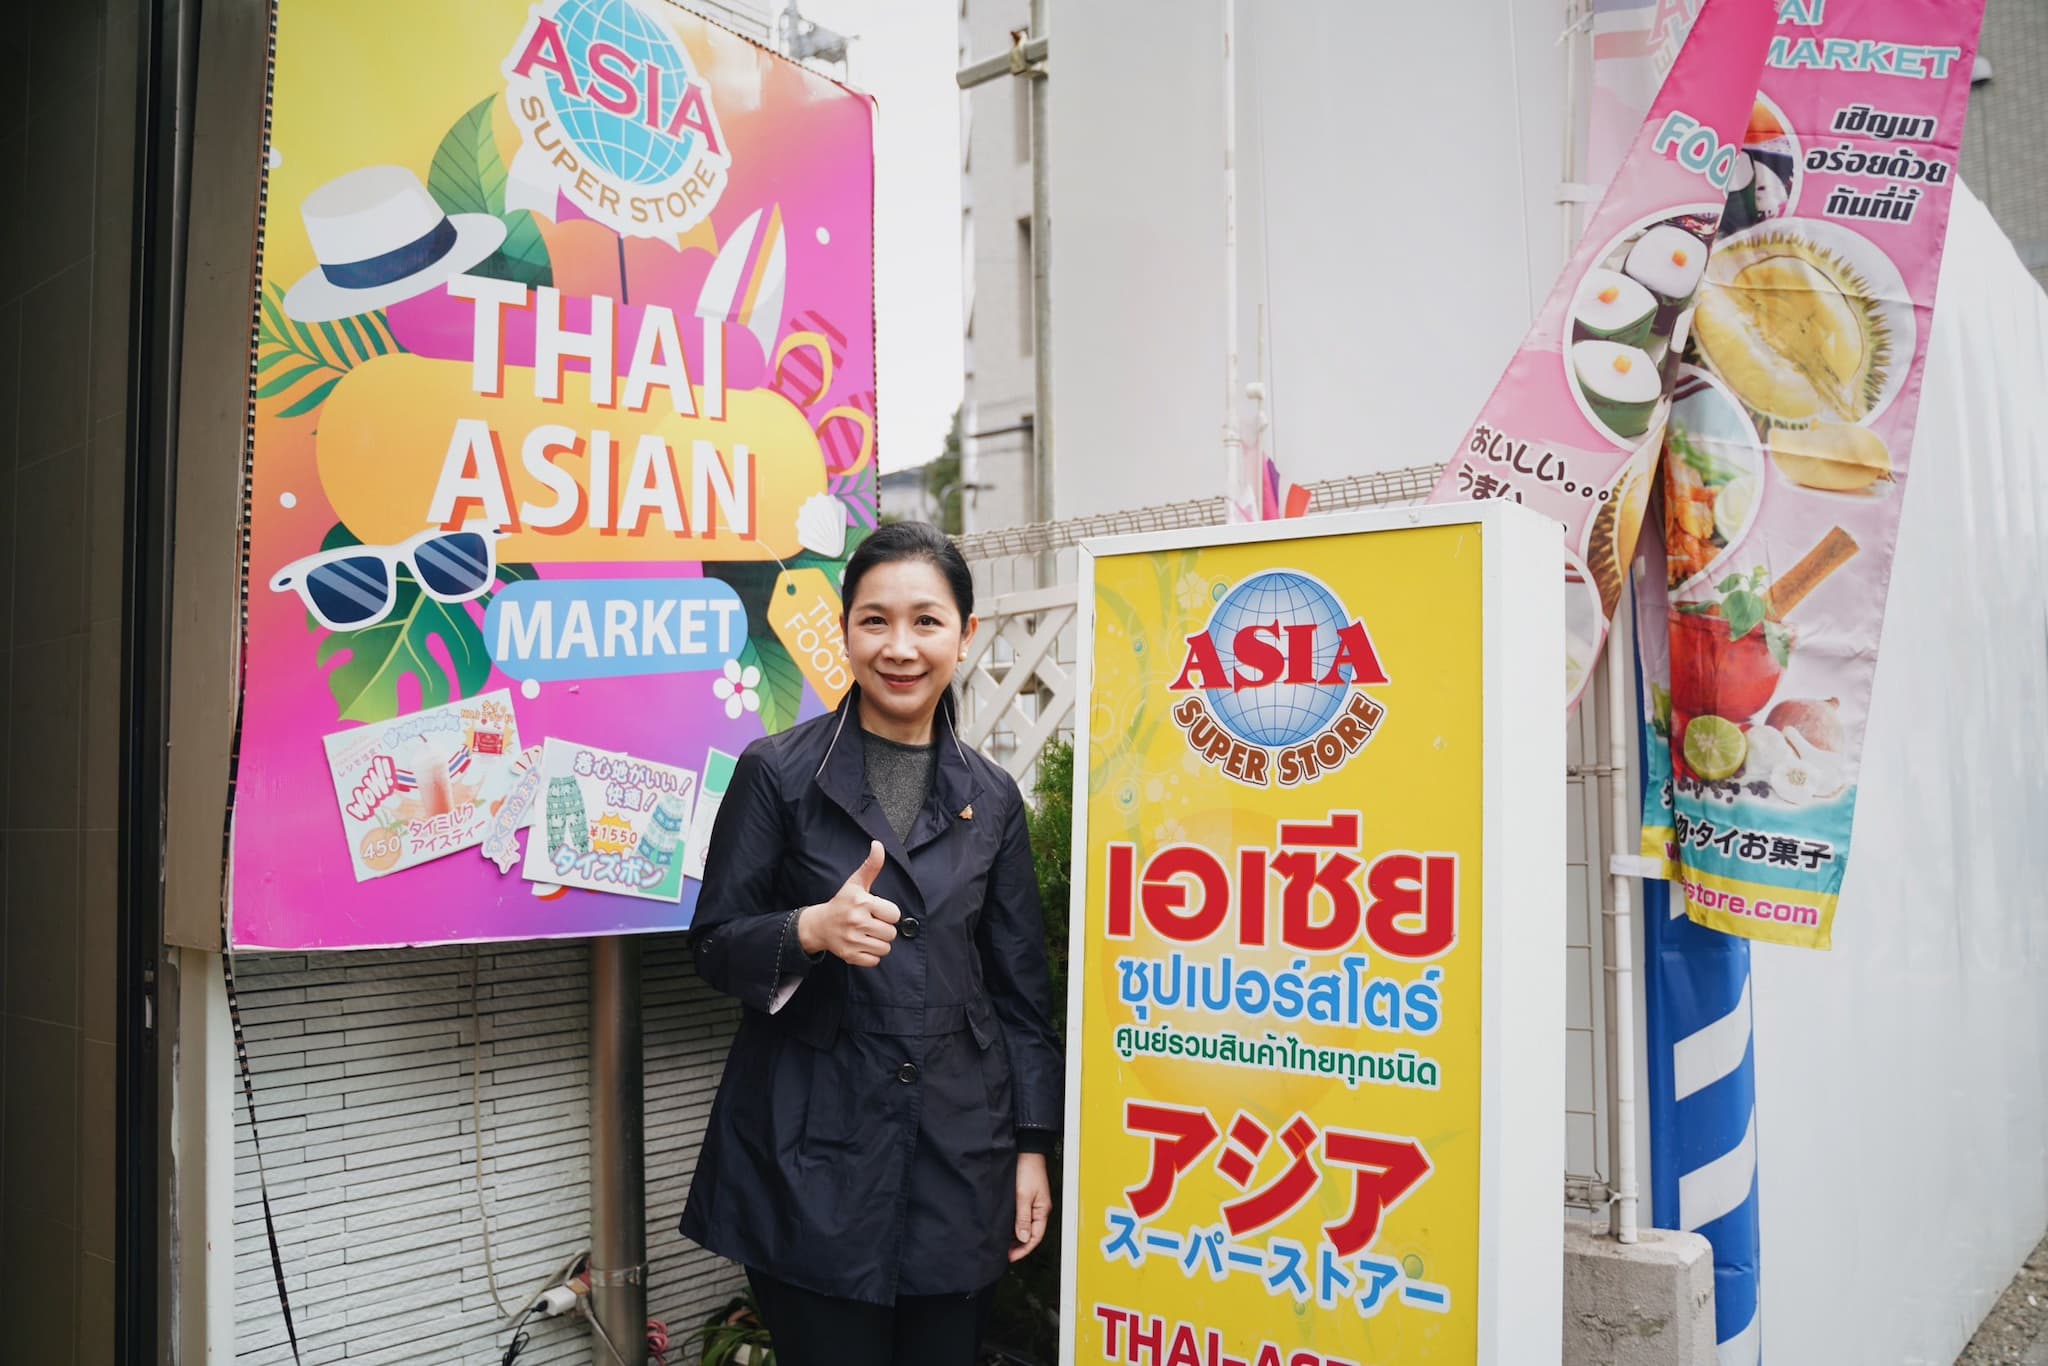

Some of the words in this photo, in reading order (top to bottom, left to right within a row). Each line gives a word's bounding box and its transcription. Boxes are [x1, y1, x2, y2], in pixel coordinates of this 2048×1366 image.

[1777, 0, 1823, 24] AI
[512, 16, 721, 155] ASIA
[1655, 113, 1735, 187] FOO
[1833, 105, 1935, 139] เชิญมา
[519, 95, 620, 216] SUPER
[629, 159, 716, 223] STORE
[1806, 144, 1948, 183] อร่อยด้วย
[447, 272, 726, 420] THAI
[427, 418, 755, 539] ASIAN
[496, 600, 740, 661] MARKET
[784, 611, 847, 690] FOOD
[809, 595, 848, 662] THA
[1169, 619, 1388, 693] ASIA
[1175, 697, 1267, 784] SUPER
[1279, 693, 1383, 784] STORE
[364, 835, 401, 859] 450
[410, 805, 473, 837] タイミルク
[410, 821, 485, 854] アイスティー
[590, 826, 638, 845] ¥1550
[553, 843, 664, 889] タイズボン
[1118, 955, 1440, 1031] ซุปเปอร์สโตร์
[1117, 1026, 1437, 1084] ศูนย์รวมสินค้าไทยทุกชนิด
[1126, 1103, 1430, 1257] アジア
[1106, 1214, 1444, 1309] スーパーストアー
